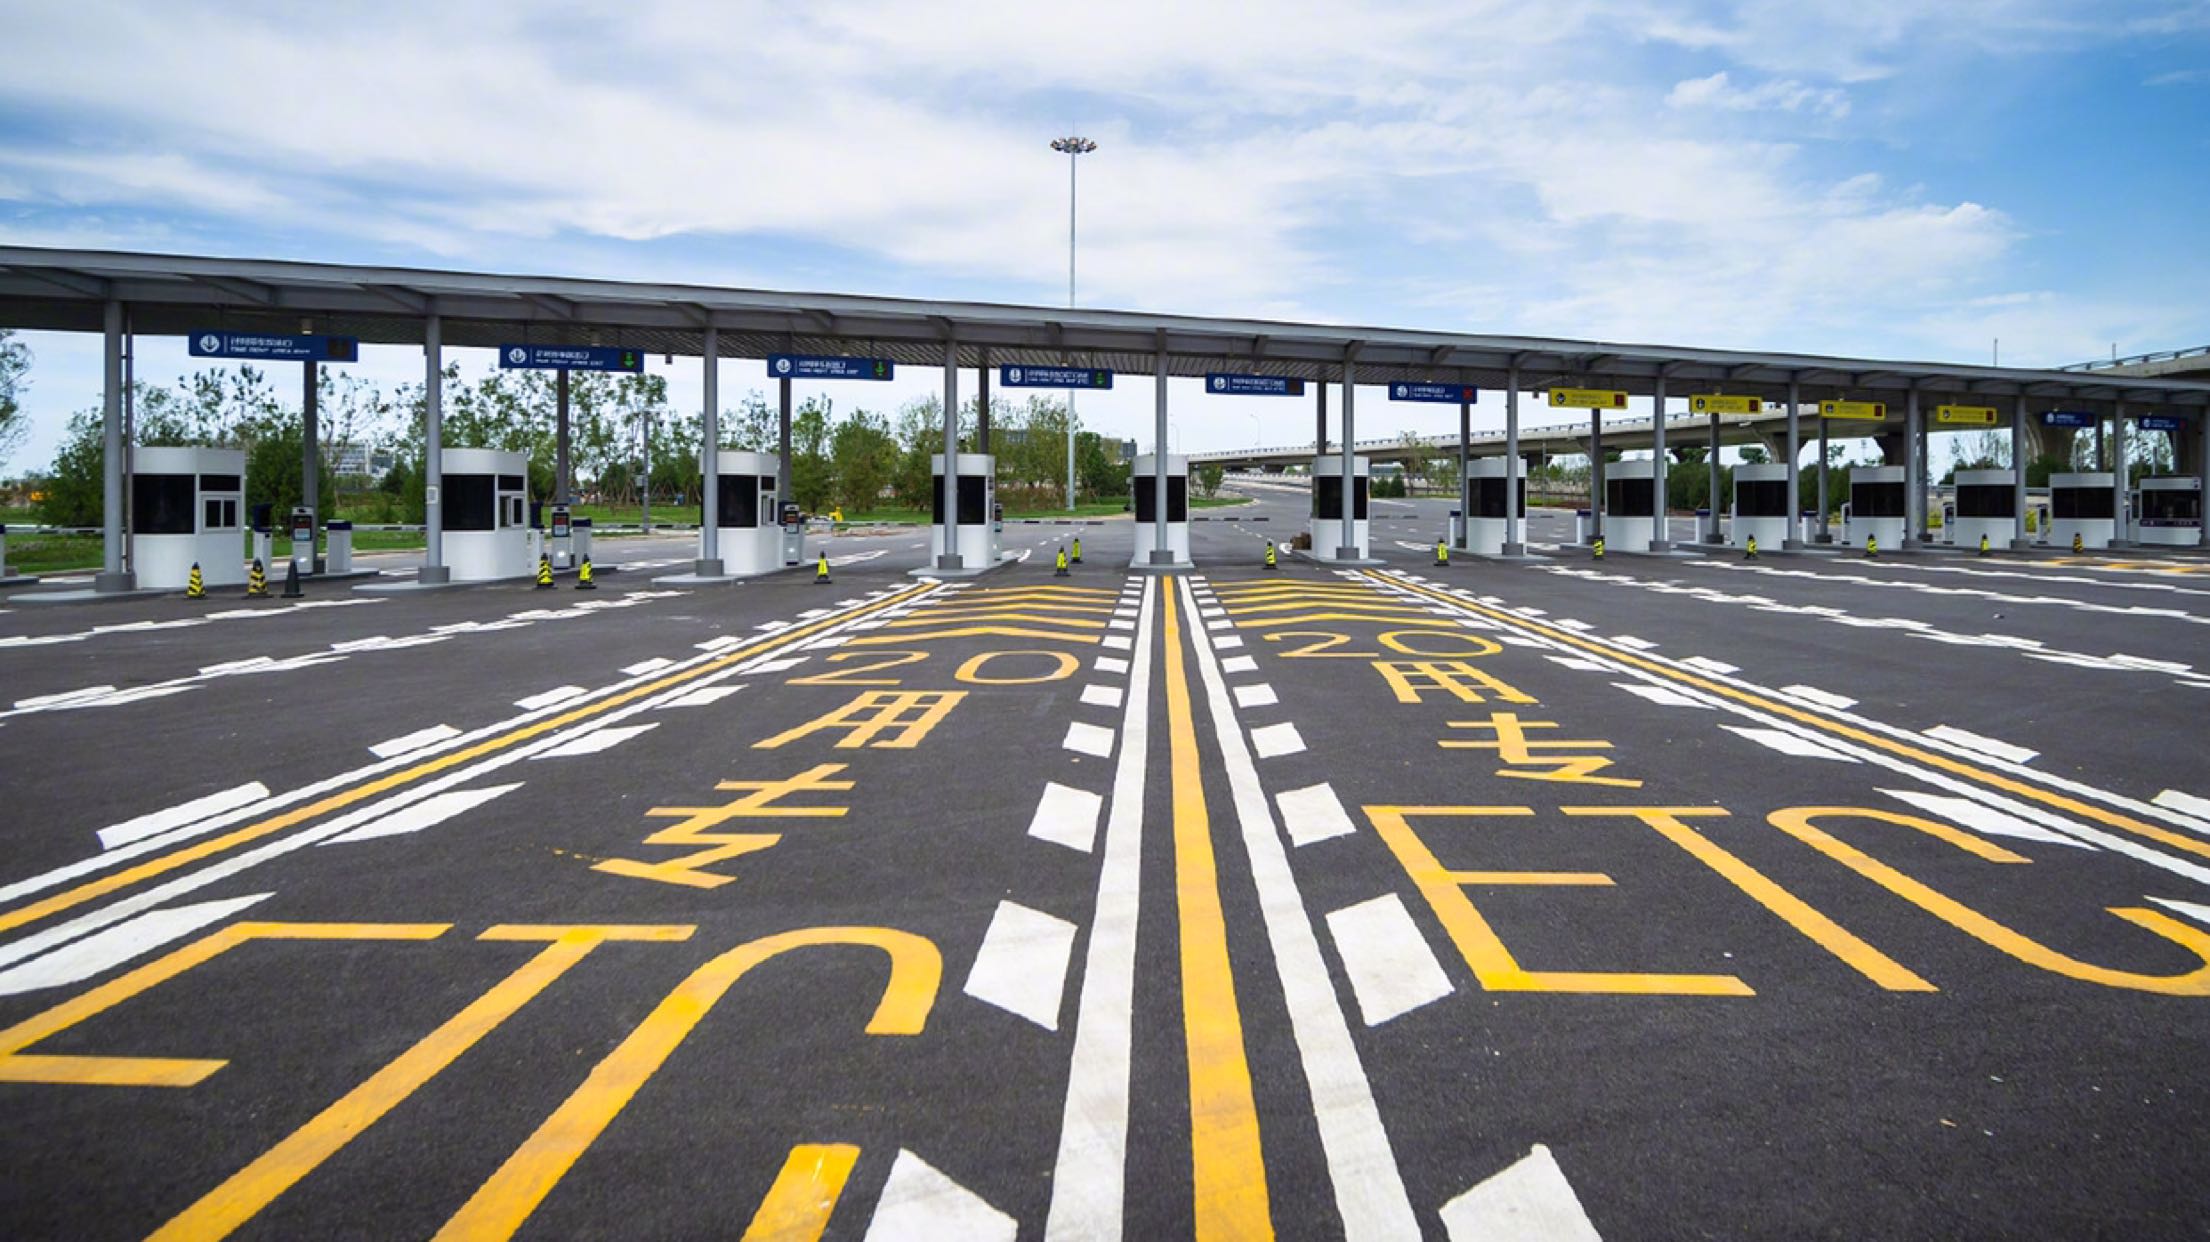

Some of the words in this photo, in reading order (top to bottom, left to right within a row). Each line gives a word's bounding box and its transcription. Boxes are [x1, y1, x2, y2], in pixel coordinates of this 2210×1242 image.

[1262, 630, 1503, 658] 20
[785, 651, 1080, 685] 20
[1362, 805, 2210, 997] ETC
